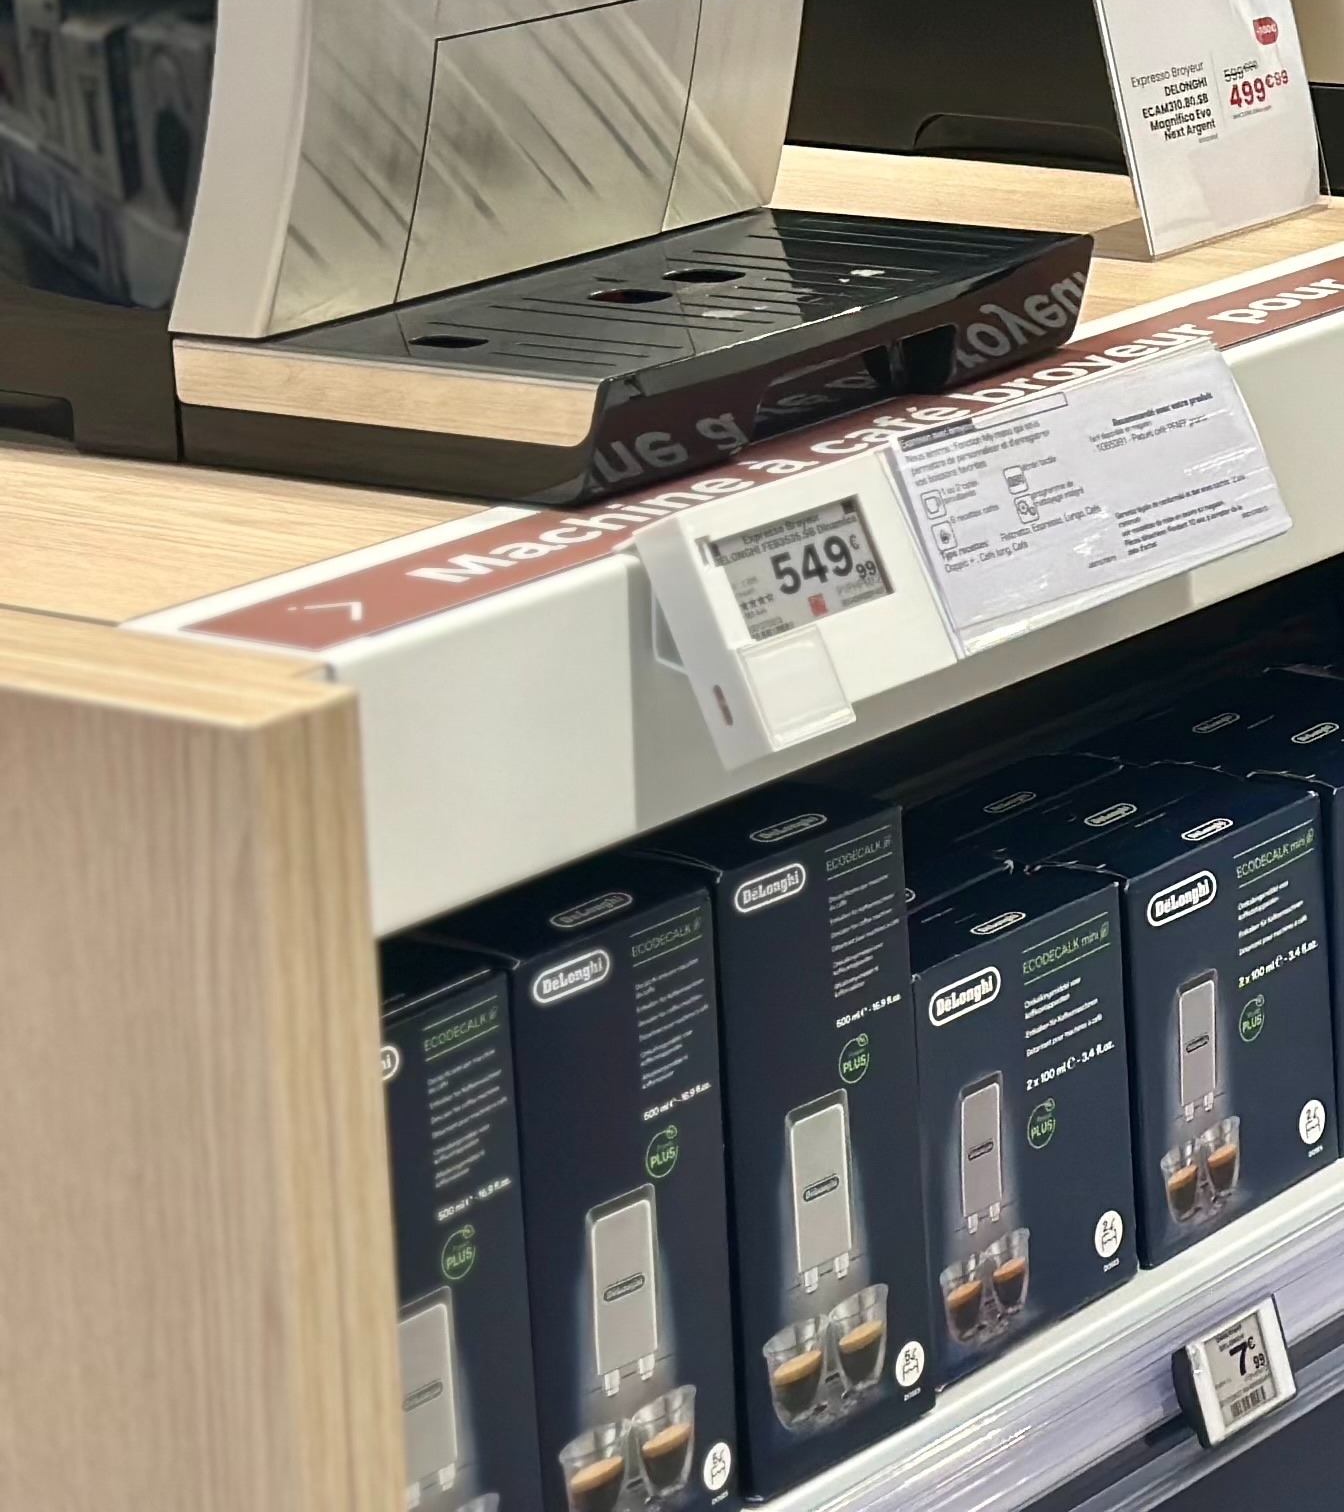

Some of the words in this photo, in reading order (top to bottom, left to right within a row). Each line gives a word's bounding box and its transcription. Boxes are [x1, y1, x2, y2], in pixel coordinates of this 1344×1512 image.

[1131, 72, 1170, 88] Expresso
[1171, 61, 1204, 78] Broyeur
[1164, 77, 1208, 96] DELONGHI
[1150, 113, 1195, 132] Magnifica
[1195, 108, 1212, 119] Evo
[1164, 127, 1185, 141] Next
[1186, 119, 1216, 135] Argent
[407, 476, 755, 583] Machine
[737, 456, 818, 475] à
[811, 405, 970, 455] café
[953, 322, 1214, 405] broyeur
[742, 525, 784, 545] Expresso
[785, 514, 819, 530] Broyeur
[817, 515, 857, 534] Dinamica
[770, 535, 853, 595] 549
[856, 561, 877, 579] 99
[826, 842, 882, 872] ECODECALK
[1237, 846, 1289, 879] ECODECALK
[632, 923, 693, 958] ECODECALK
[1023, 937, 1080, 975] ECODECALK
[1081, 932, 1101, 947] mini
[1250, 967, 1264, 981] 100
[1288, 948, 1301, 962] 3.4
[424, 1015, 488, 1052] ECODECALK
[1242, 1013, 1262, 1032] PLUS
[843, 1053, 867, 1074] PLUS
[1040, 1068, 1055, 1083] 100
[1081, 1048, 1095, 1063] 3.4
[1030, 1119, 1053, 1139] PLUS
[650, 1146, 676, 1169] PLUS
[438, 1207, 454, 1221] 500
[478, 1185, 494, 1199] 16.9
[446, 1247, 472, 1270] PLUS
[1229, 1342, 1248, 1376] 7
[1248, 1336, 1256, 1350] €
[1253, 1353, 1265, 1369] 99
